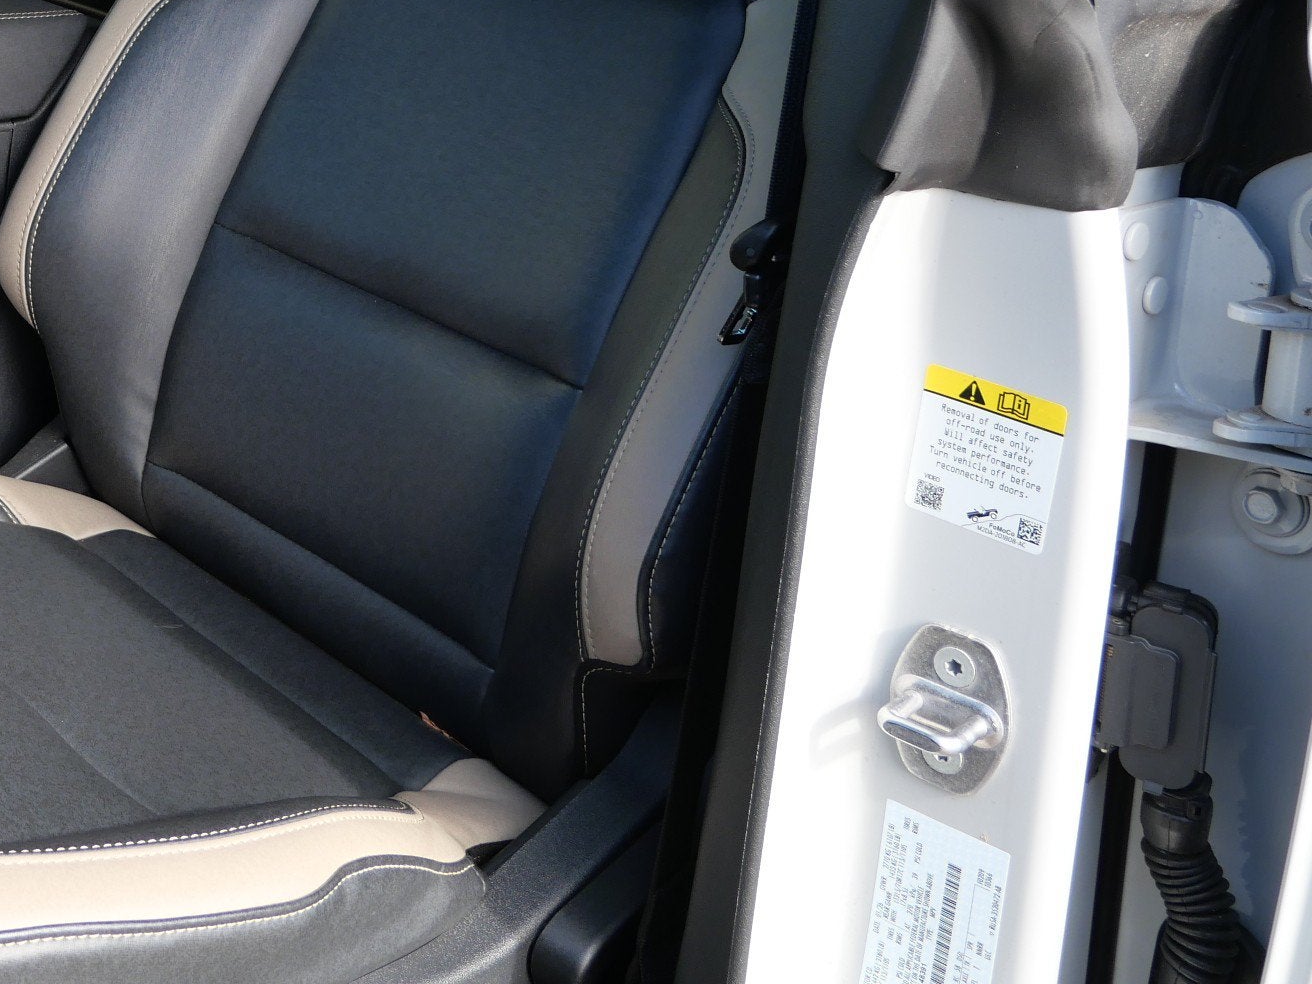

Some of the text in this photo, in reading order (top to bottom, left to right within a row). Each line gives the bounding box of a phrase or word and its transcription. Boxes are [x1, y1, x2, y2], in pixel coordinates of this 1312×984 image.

[942, 403, 975, 419] Removal
[994, 422, 1019, 437] doors
[1024, 432, 1039, 443] for
[946, 418, 1034, 454] off-road use only.
[938, 438, 1030, 476] system performance.
[944, 427, 1033, 466] Will affect safety
[929, 445, 1041, 492] Turn vehicle off before
[936, 460, 1028, 499] reconnecting doors.
